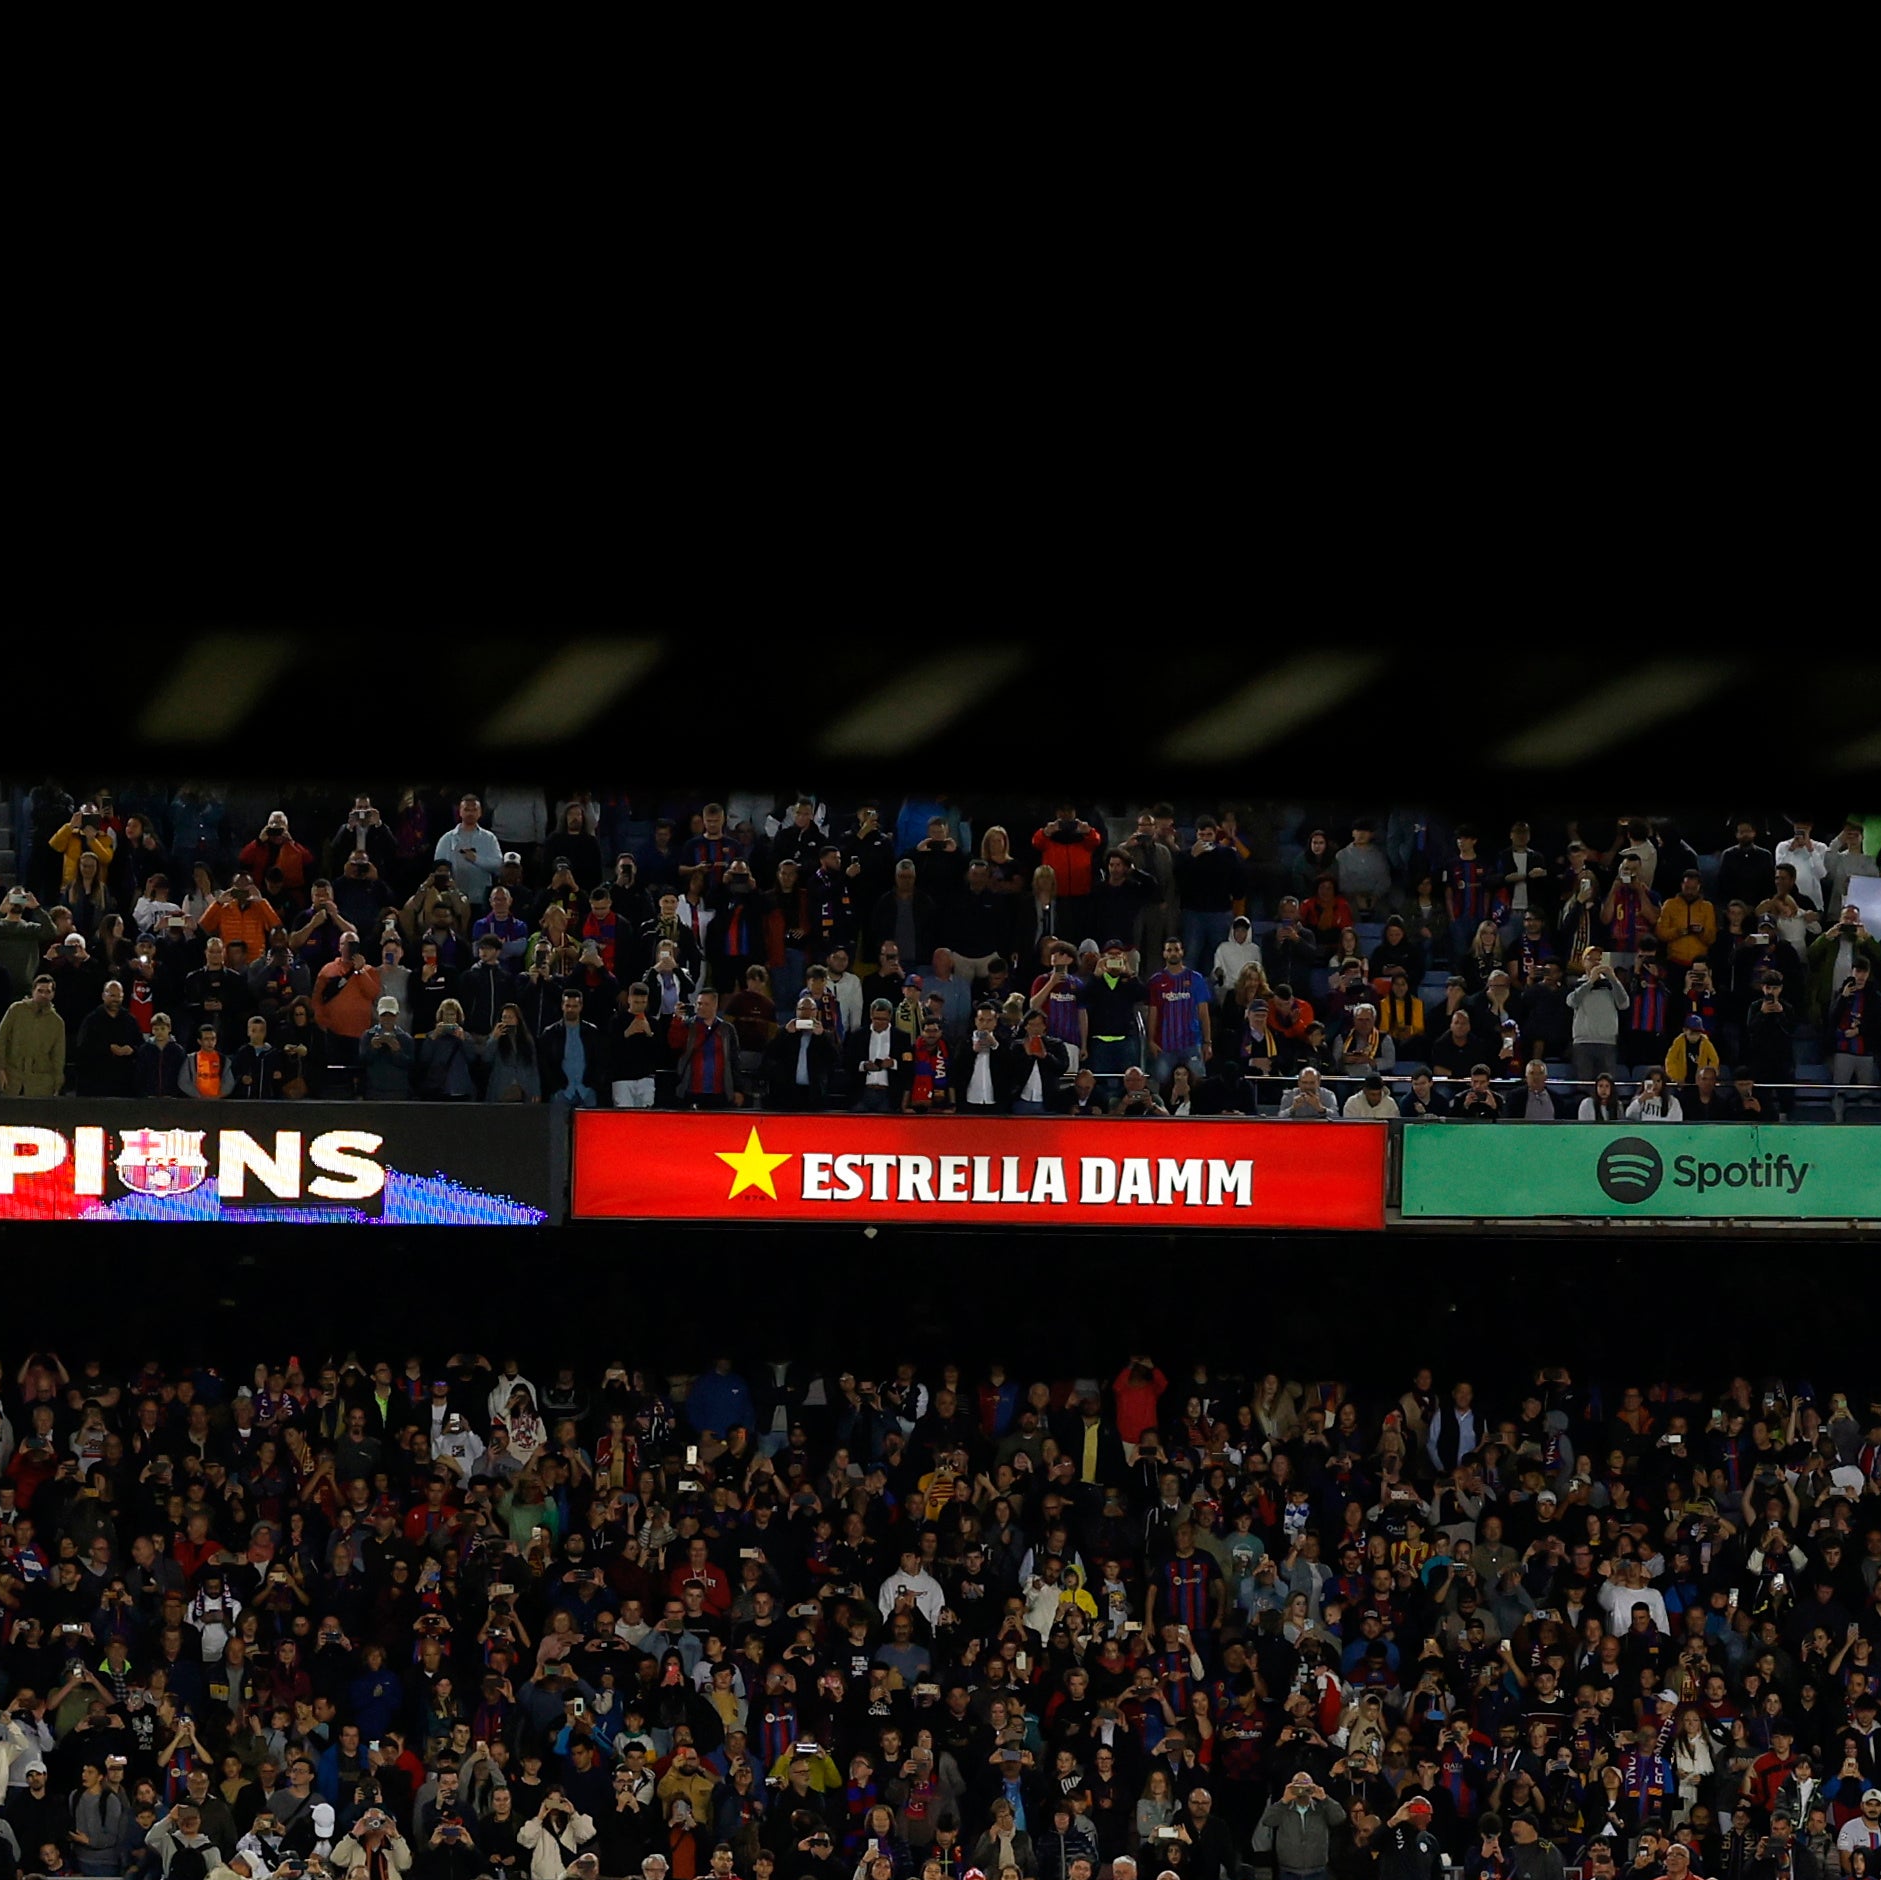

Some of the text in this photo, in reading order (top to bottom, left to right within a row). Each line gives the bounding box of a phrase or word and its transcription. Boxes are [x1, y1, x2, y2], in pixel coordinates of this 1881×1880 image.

[801, 1151, 1254, 1208] ESTRELLA DAMM
[1673, 1152, 1809, 1194] Spotify
